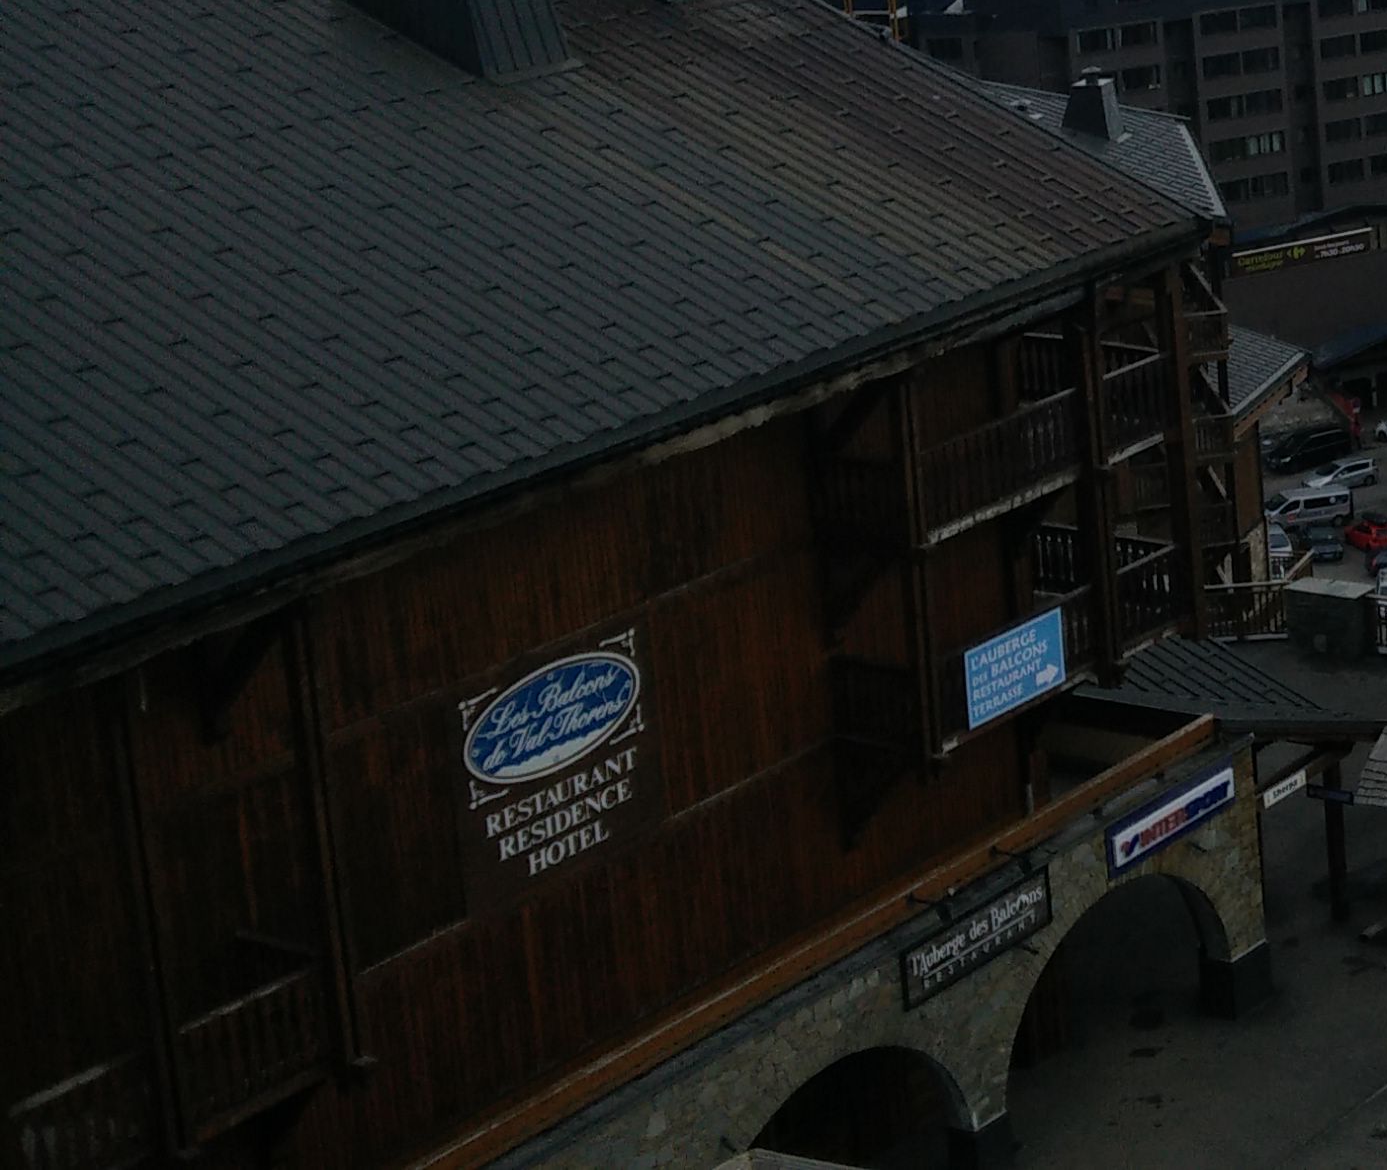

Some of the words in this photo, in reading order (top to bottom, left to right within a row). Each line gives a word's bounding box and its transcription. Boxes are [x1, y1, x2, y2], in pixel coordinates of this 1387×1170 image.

[971, 629, 1036, 671] L'AUBERGE
[973, 658, 1042, 701] RESTAURANT
[991, 640, 1048, 677] BALCONS
[480, 695, 531, 738] Les
[535, 666, 620, 714] Balcons
[482, 737, 507, 771] de
[509, 715, 551, 759] Val
[552, 680, 631, 741] Thorens
[973, 683, 1024, 717] TERRASSE
[485, 747, 637, 838] RESTAURANT
[499, 780, 633, 861] RESIDENCE
[1141, 780, 1230, 847] INTERSPORT
[528, 821, 610, 877] HOTEL
[911, 933, 966, 976] l'Auberge
[969, 920, 989, 940] des
[990, 886, 1043, 930] Balcons
[923, 913, 1035, 989] RESTAURANT
